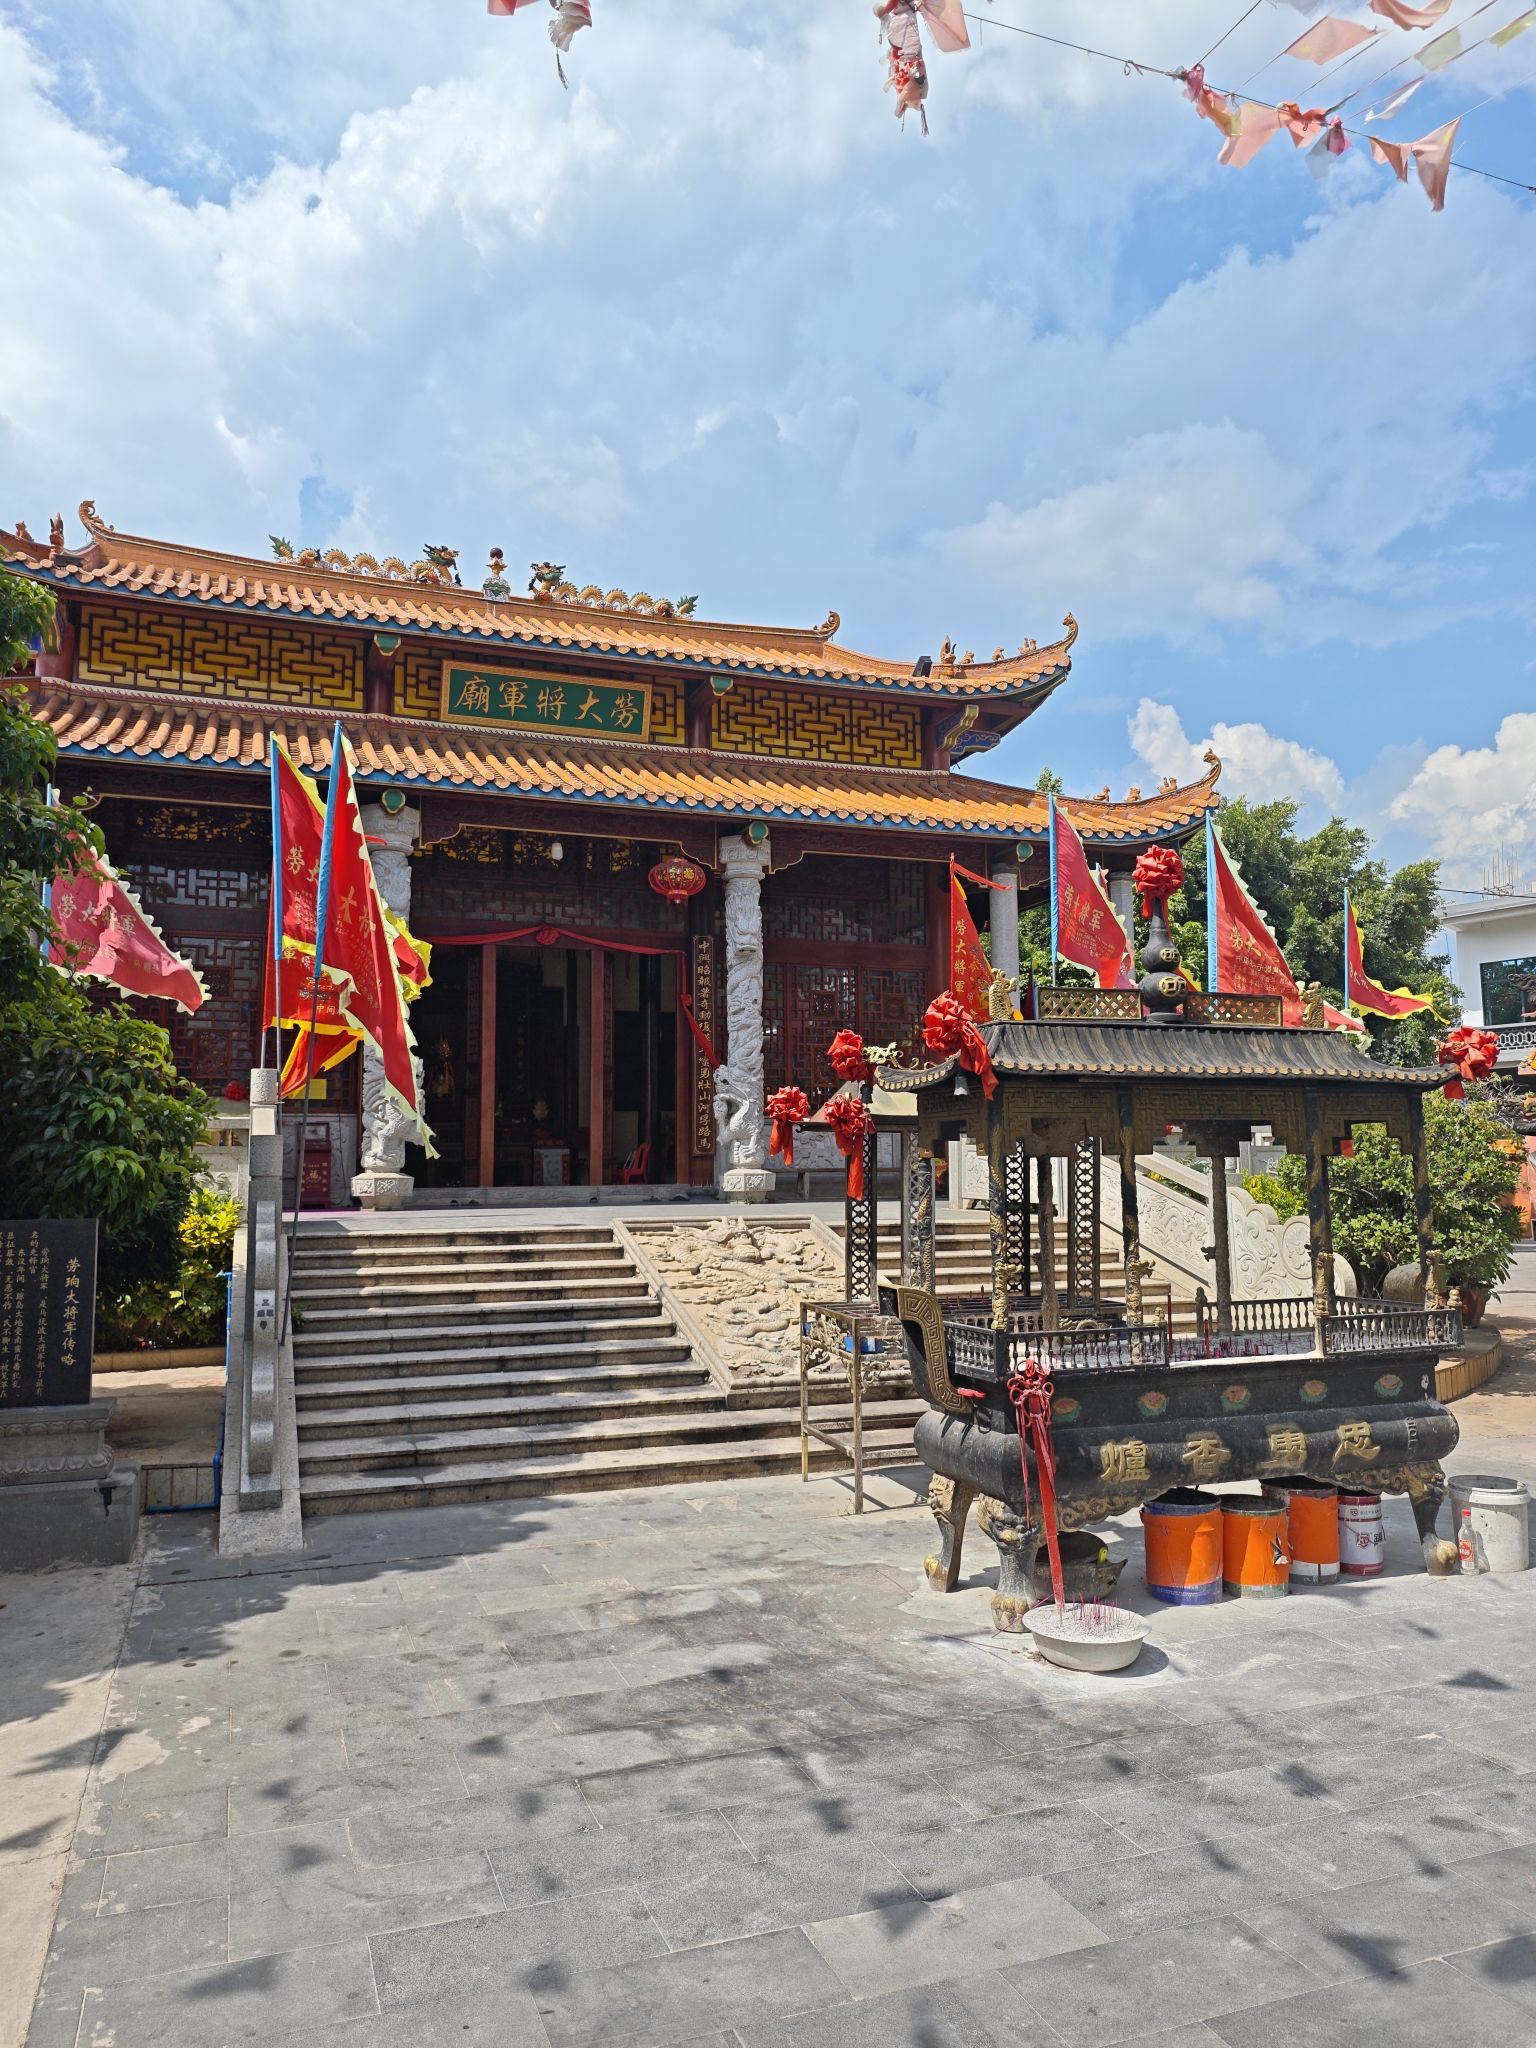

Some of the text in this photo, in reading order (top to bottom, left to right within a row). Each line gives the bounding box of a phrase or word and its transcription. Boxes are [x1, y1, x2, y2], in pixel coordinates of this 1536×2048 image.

[453, 675, 640, 729] 勞大將軍廟
